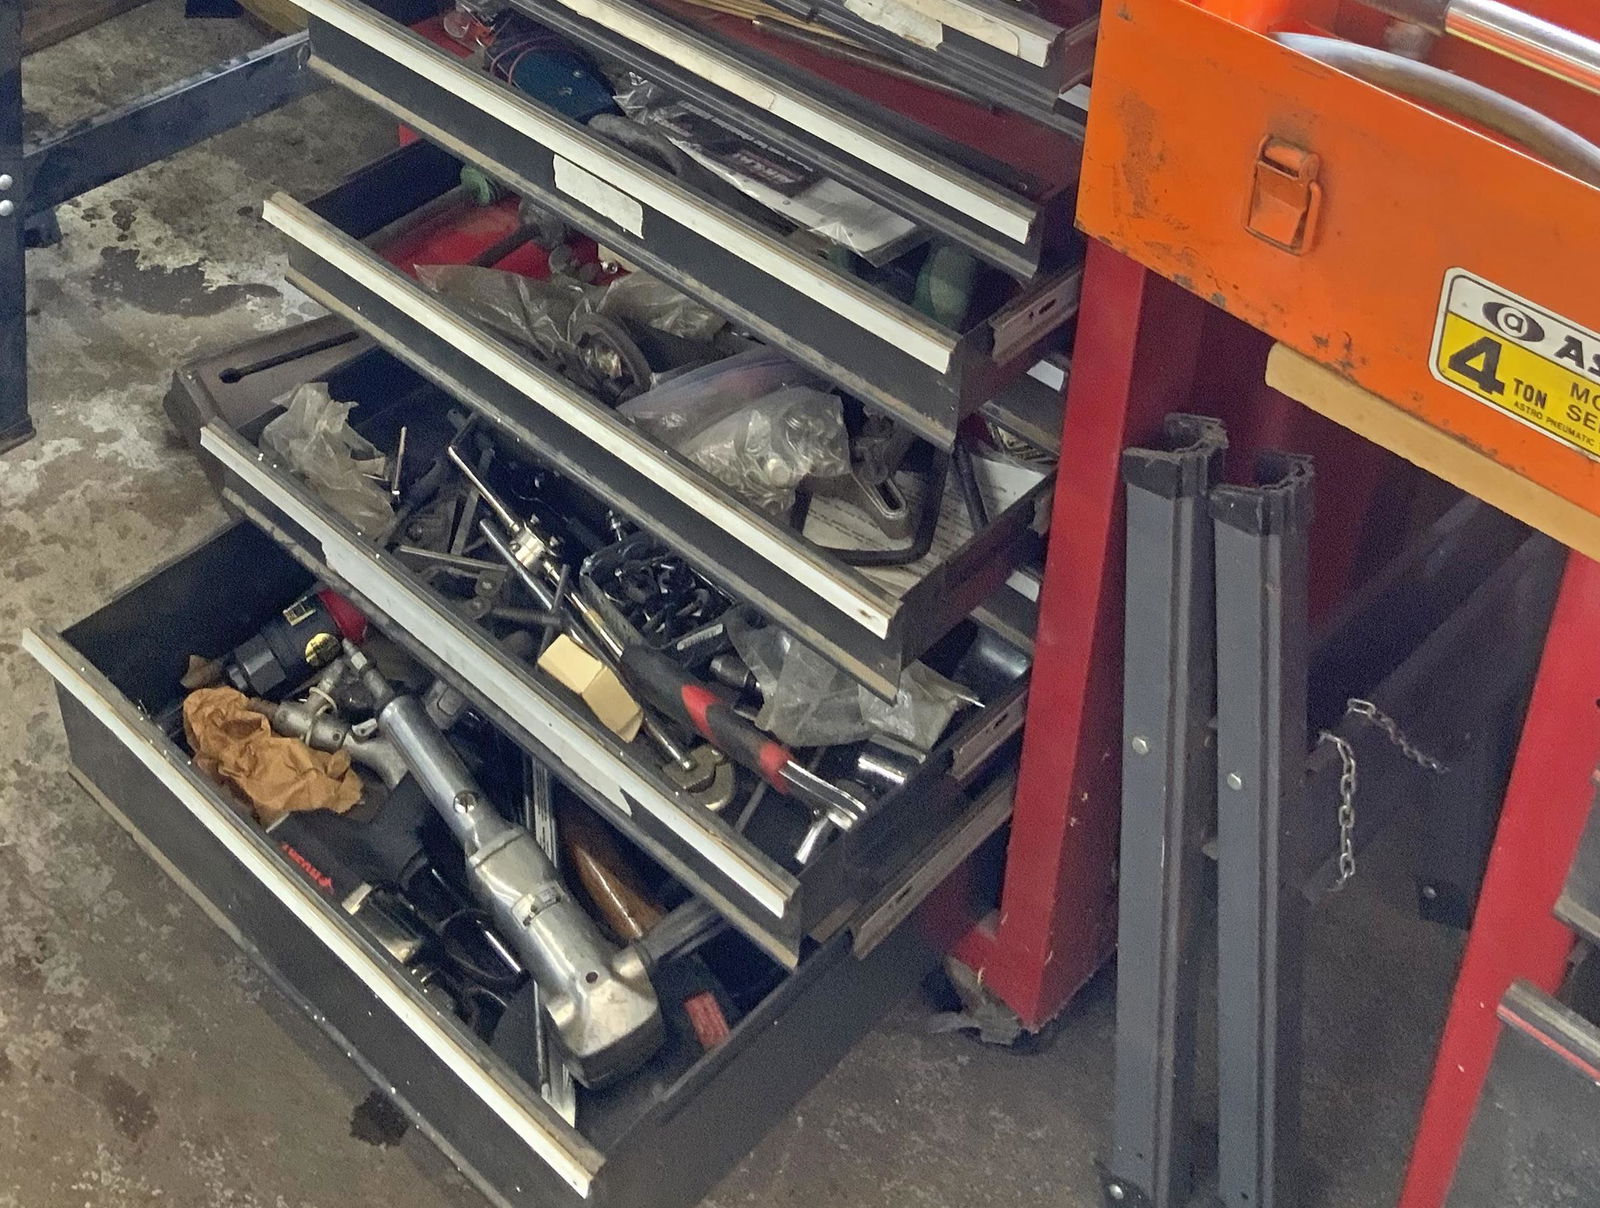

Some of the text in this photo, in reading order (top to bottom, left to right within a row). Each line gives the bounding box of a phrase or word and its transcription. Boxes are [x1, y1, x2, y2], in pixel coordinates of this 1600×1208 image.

[1448, 337, 1548, 411] 4 TON
[1514, 401, 1595, 446] ASTRO PNEUMATIC
[1566, 404, 1600, 434] SE
